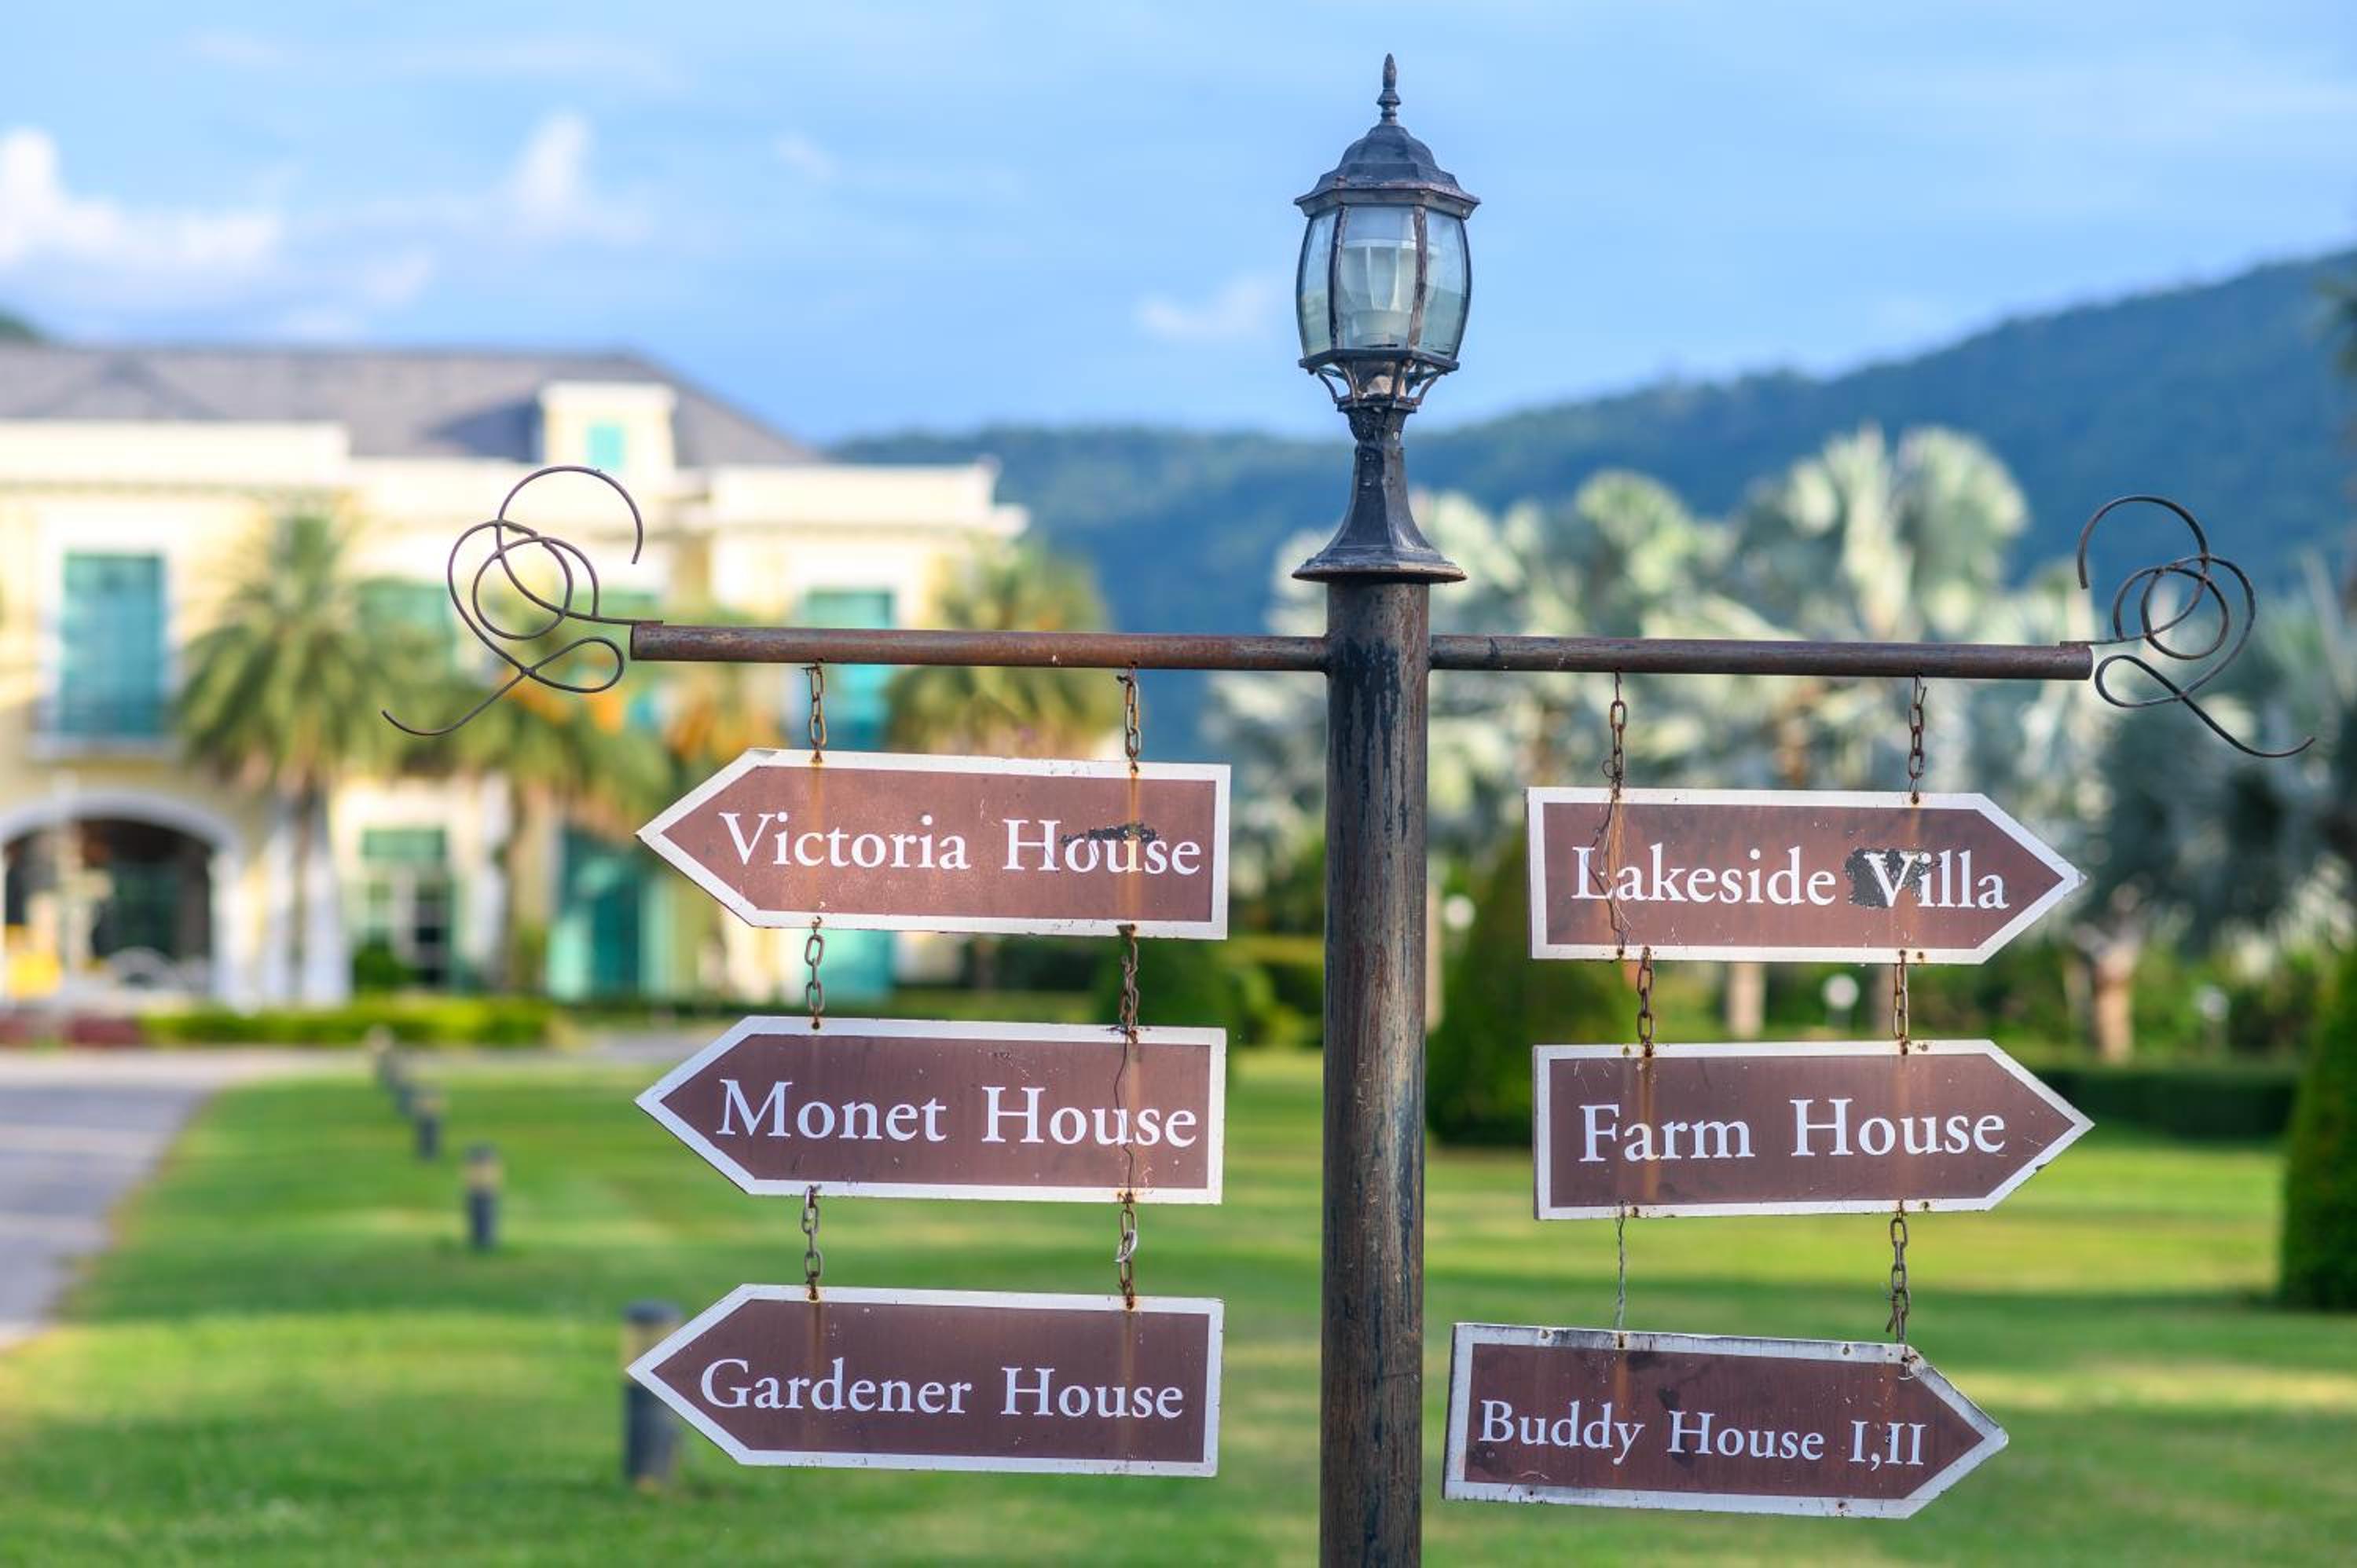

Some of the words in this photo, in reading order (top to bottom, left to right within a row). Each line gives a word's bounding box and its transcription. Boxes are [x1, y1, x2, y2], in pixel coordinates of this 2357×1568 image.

[719, 811, 971, 870] Victoria
[1003, 819, 1201, 875] House
[1571, 842, 1836, 906] Lakeside
[1864, 848, 2010, 909] Villa
[716, 1078, 947, 1142] Monet
[981, 1086, 1197, 1148] House
[1578, 1104, 1754, 1162] Farm
[1789, 1097, 2006, 1157] House
[700, 1357, 973, 1415] Gardener
[999, 1366, 1184, 1419] House
[1478, 1400, 1645, 1465] Buddy
[1666, 1410, 1824, 1460] House
[1847, 1420, 1926, 1471] I,II
